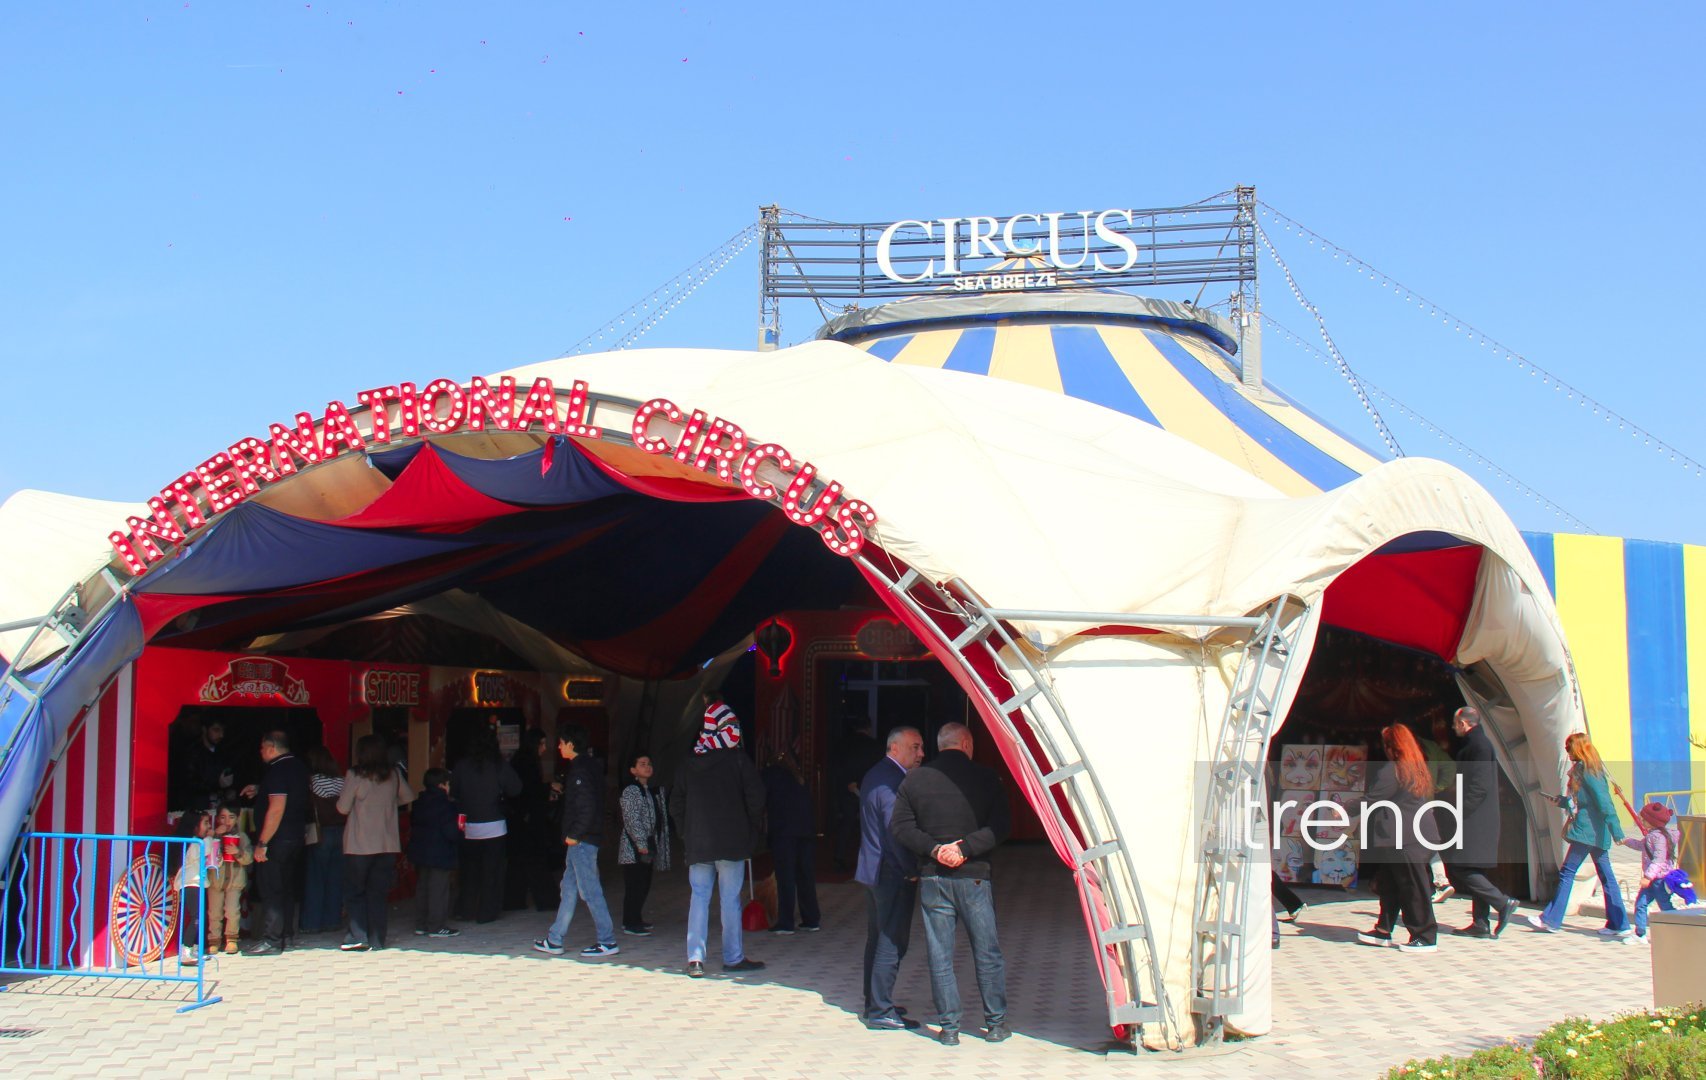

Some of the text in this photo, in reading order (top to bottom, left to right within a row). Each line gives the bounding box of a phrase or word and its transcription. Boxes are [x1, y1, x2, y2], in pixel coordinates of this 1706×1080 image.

[876, 209, 1138, 283] CIRCUS
[953, 273, 1057, 291] SEA BREEZE
[107, 375, 878, 575] INTERNATIONAL CIRCUS
[365, 670, 421, 705] STORE
[479, 676, 505, 700] TOYS
